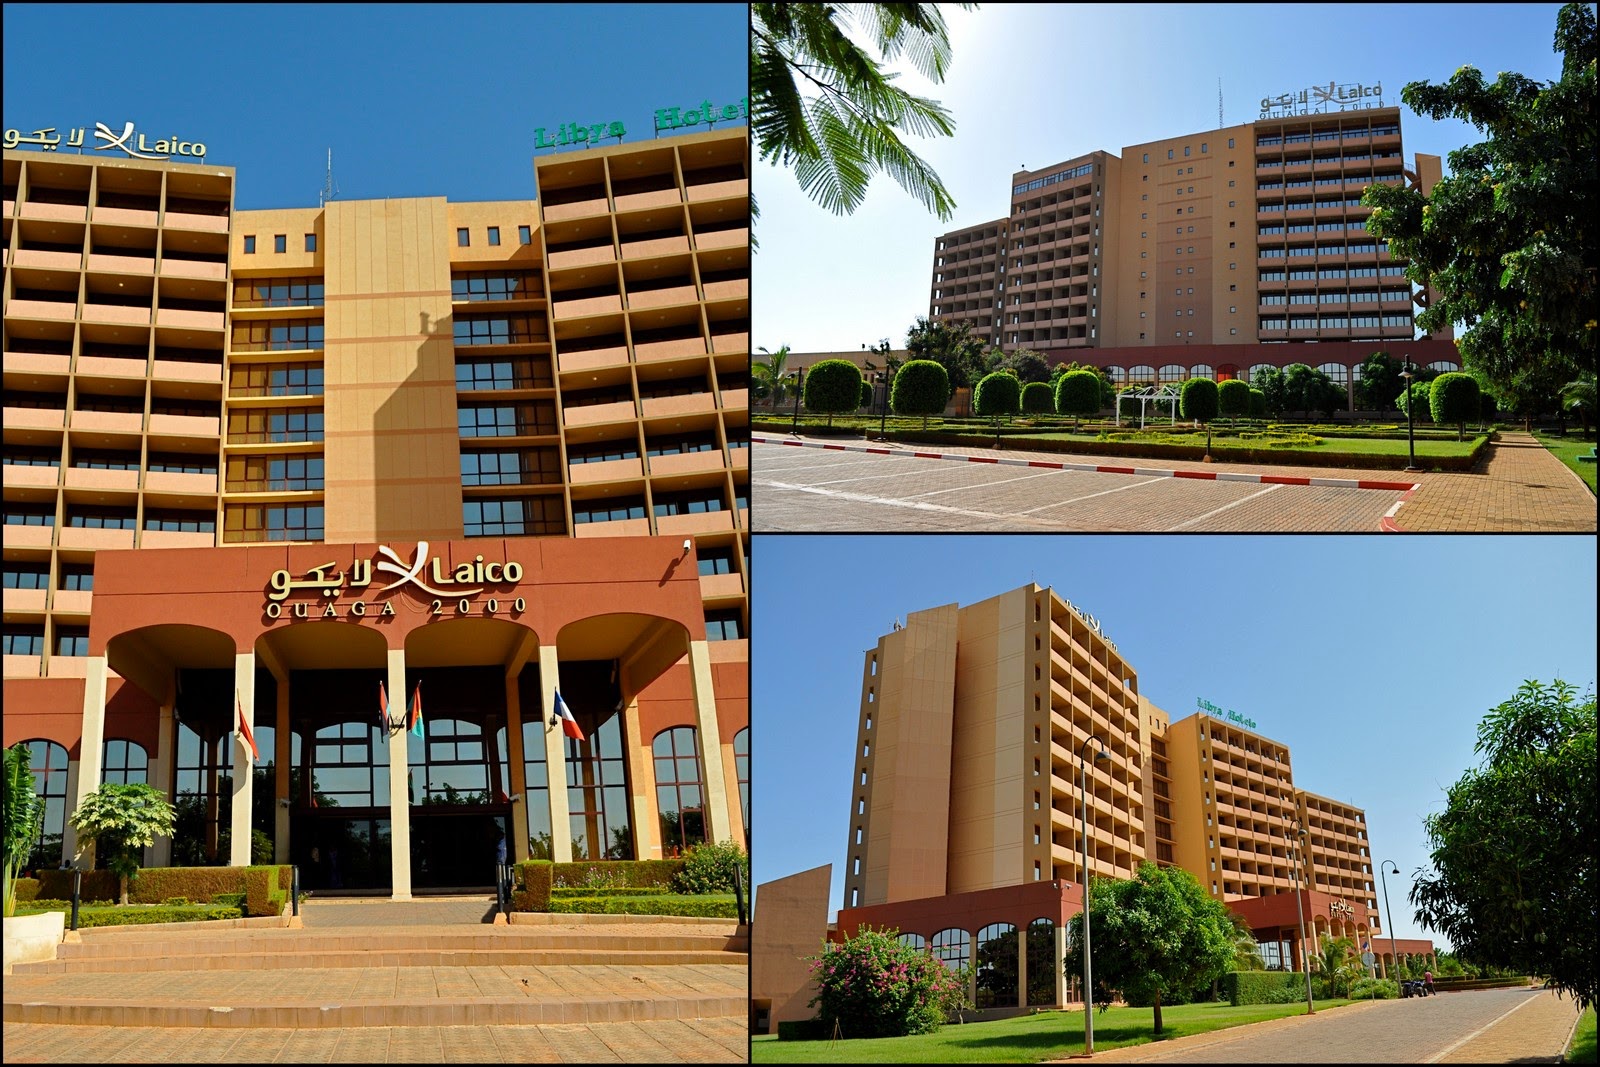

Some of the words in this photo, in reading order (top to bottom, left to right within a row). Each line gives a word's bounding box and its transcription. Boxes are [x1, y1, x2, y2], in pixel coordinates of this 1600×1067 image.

[1338, 84, 1382, 100] Laico
[1259, 107, 1321, 120] OUAGA
[1339, 100, 1384, 112] 2000
[138, 133, 207, 157] Laico
[534, 120, 627, 149] Libya
[432, 555, 524, 584] Laico
[266, 601, 396, 619] OUAGA
[432, 597, 526, 615] 2000
[1197, 697, 1223, 716] Libya
